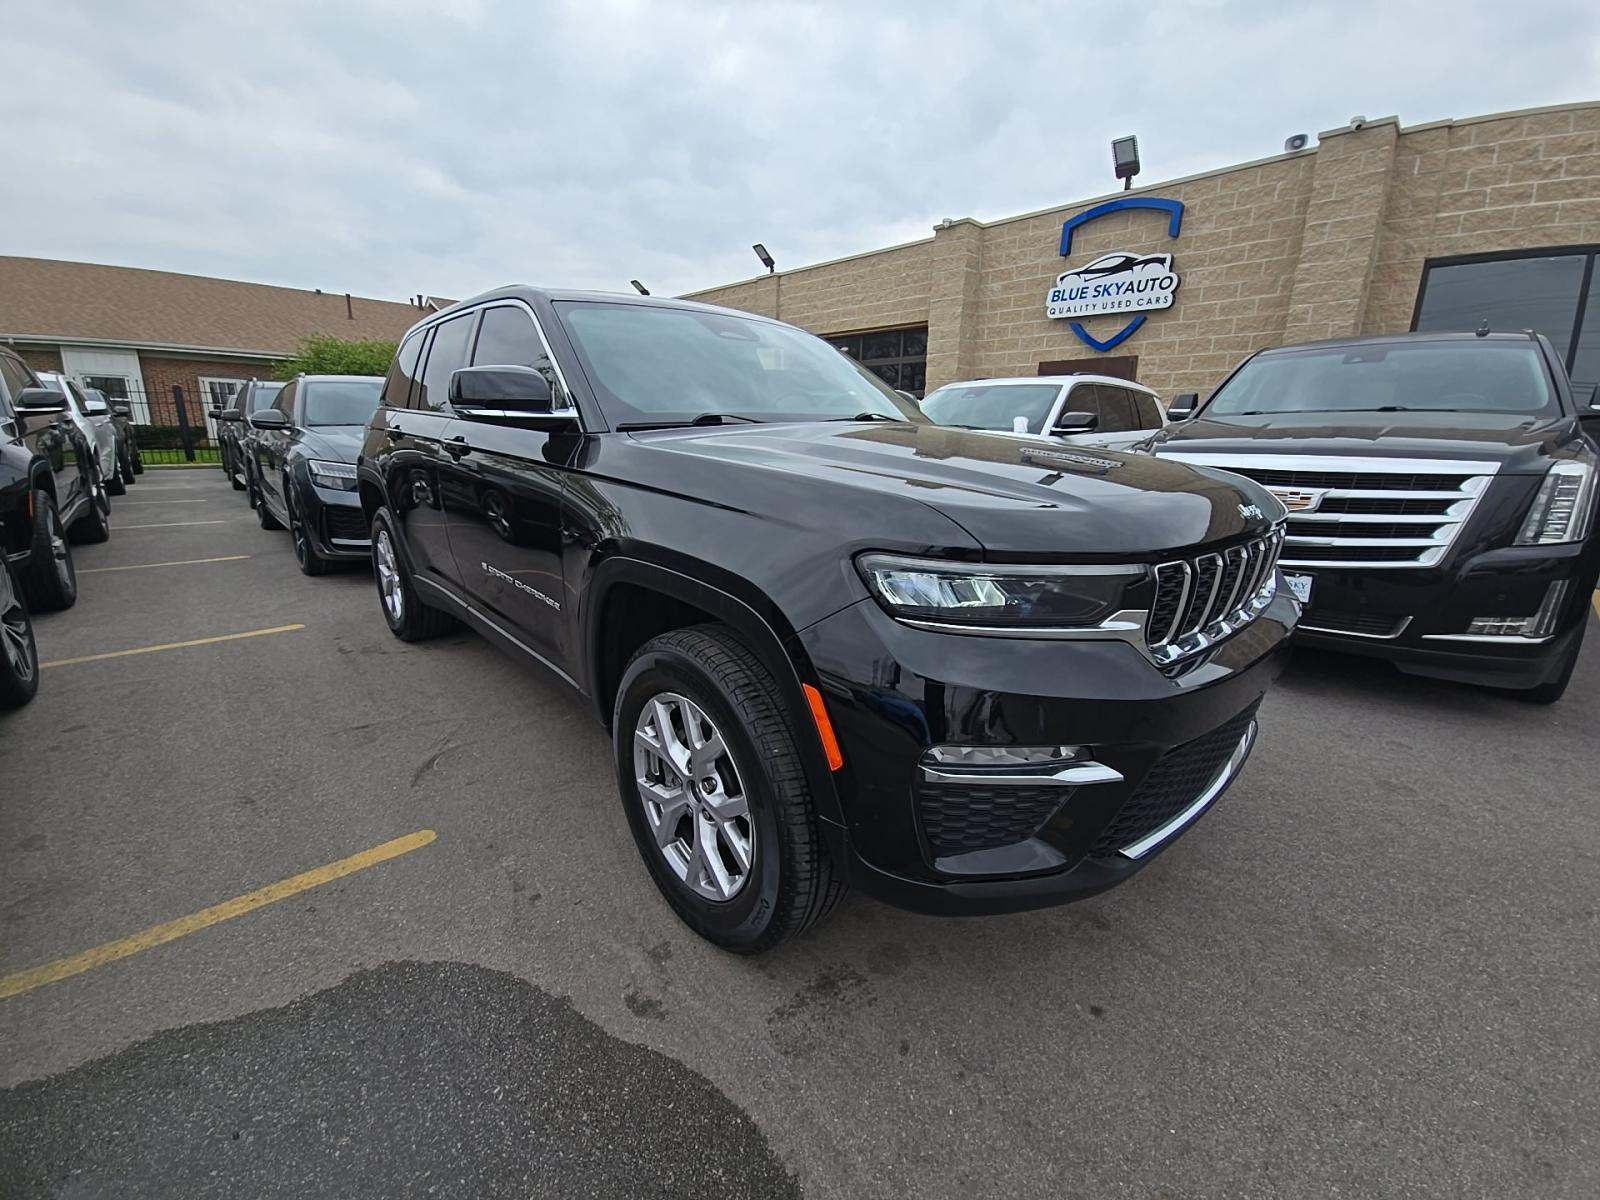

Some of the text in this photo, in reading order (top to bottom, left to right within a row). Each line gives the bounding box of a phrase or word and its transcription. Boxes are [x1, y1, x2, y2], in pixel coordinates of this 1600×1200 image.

[1051, 286, 1089, 302] BLUE
[1049, 296, 1169, 315] QUALITY USED CARS
